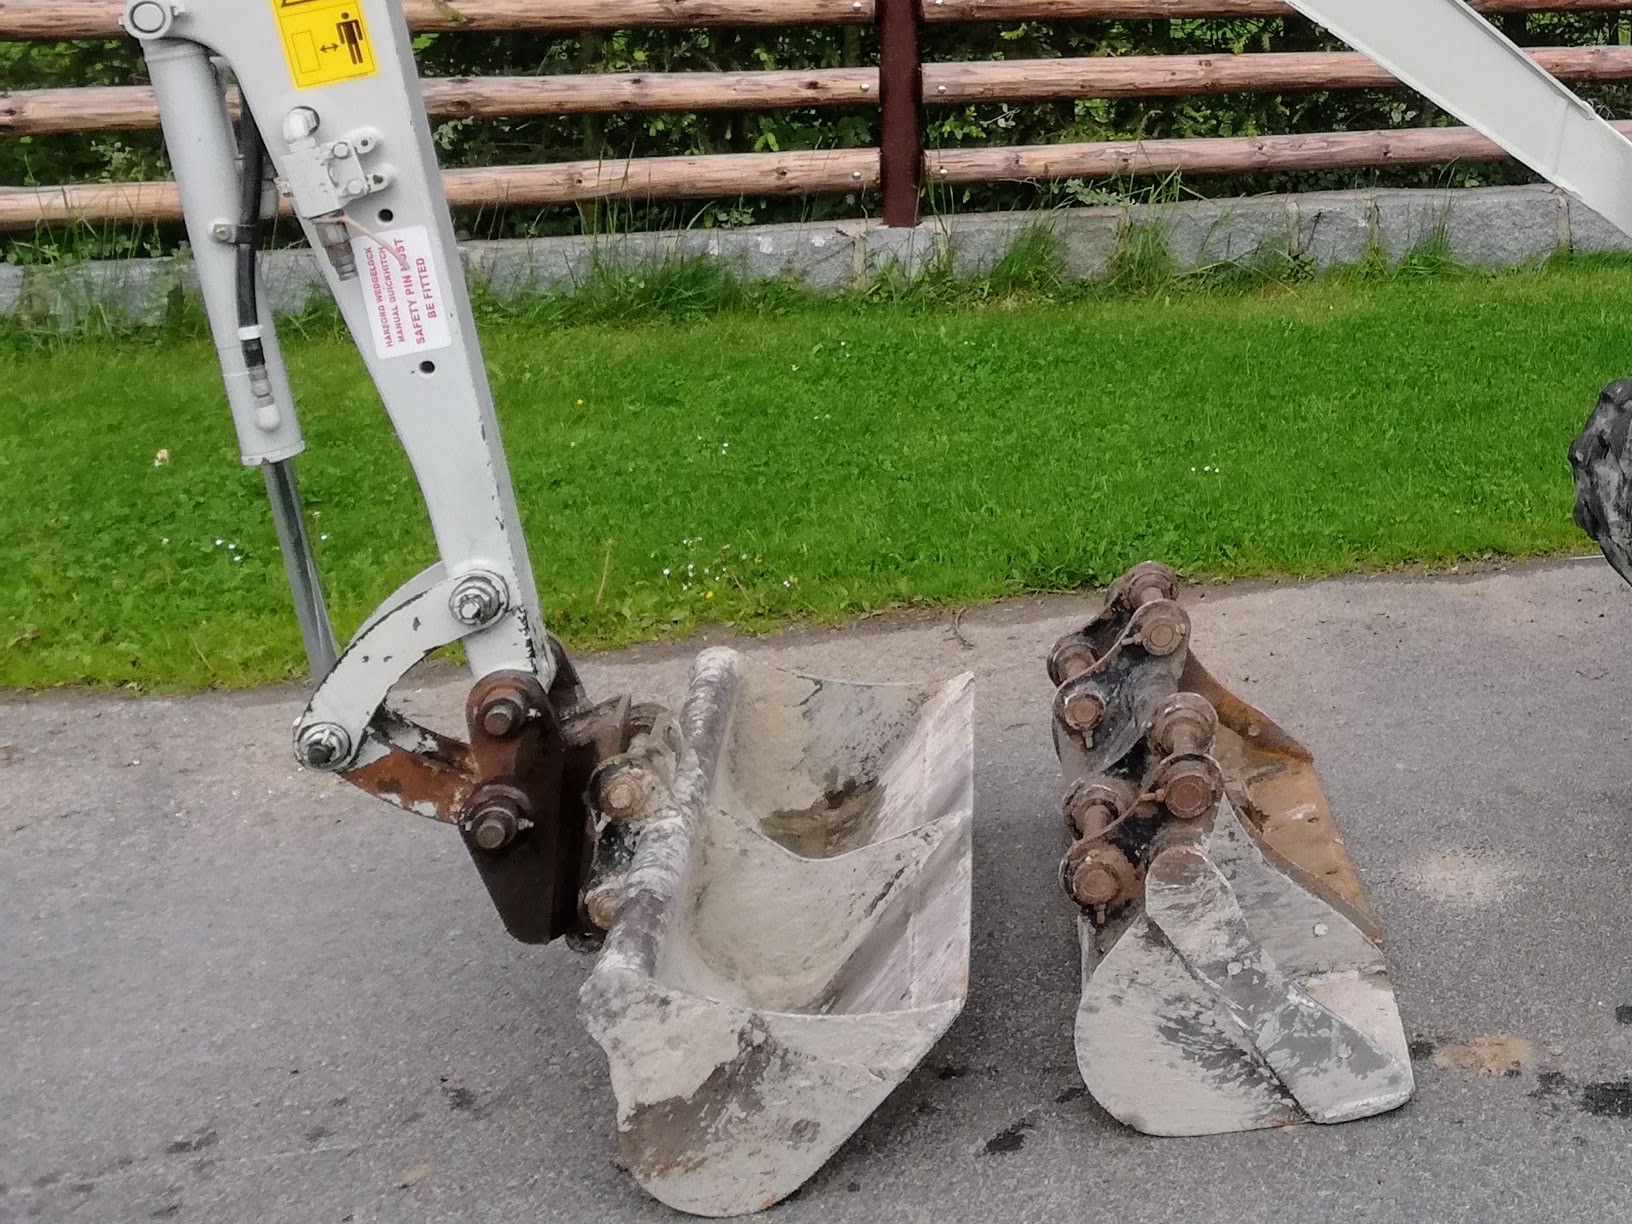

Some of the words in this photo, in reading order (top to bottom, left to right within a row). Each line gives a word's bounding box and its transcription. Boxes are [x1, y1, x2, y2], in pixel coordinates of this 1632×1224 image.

[364, 246, 383, 302] WEDGELOCK
[378, 247, 396, 302] QUICKHITCH
[401, 274, 415, 295] PIN
[416, 257, 433, 299] FITTED
[393, 306, 405, 343] MANUAL
[407, 299, 426, 345] SAFETY
[426, 303, 437, 319] BE
